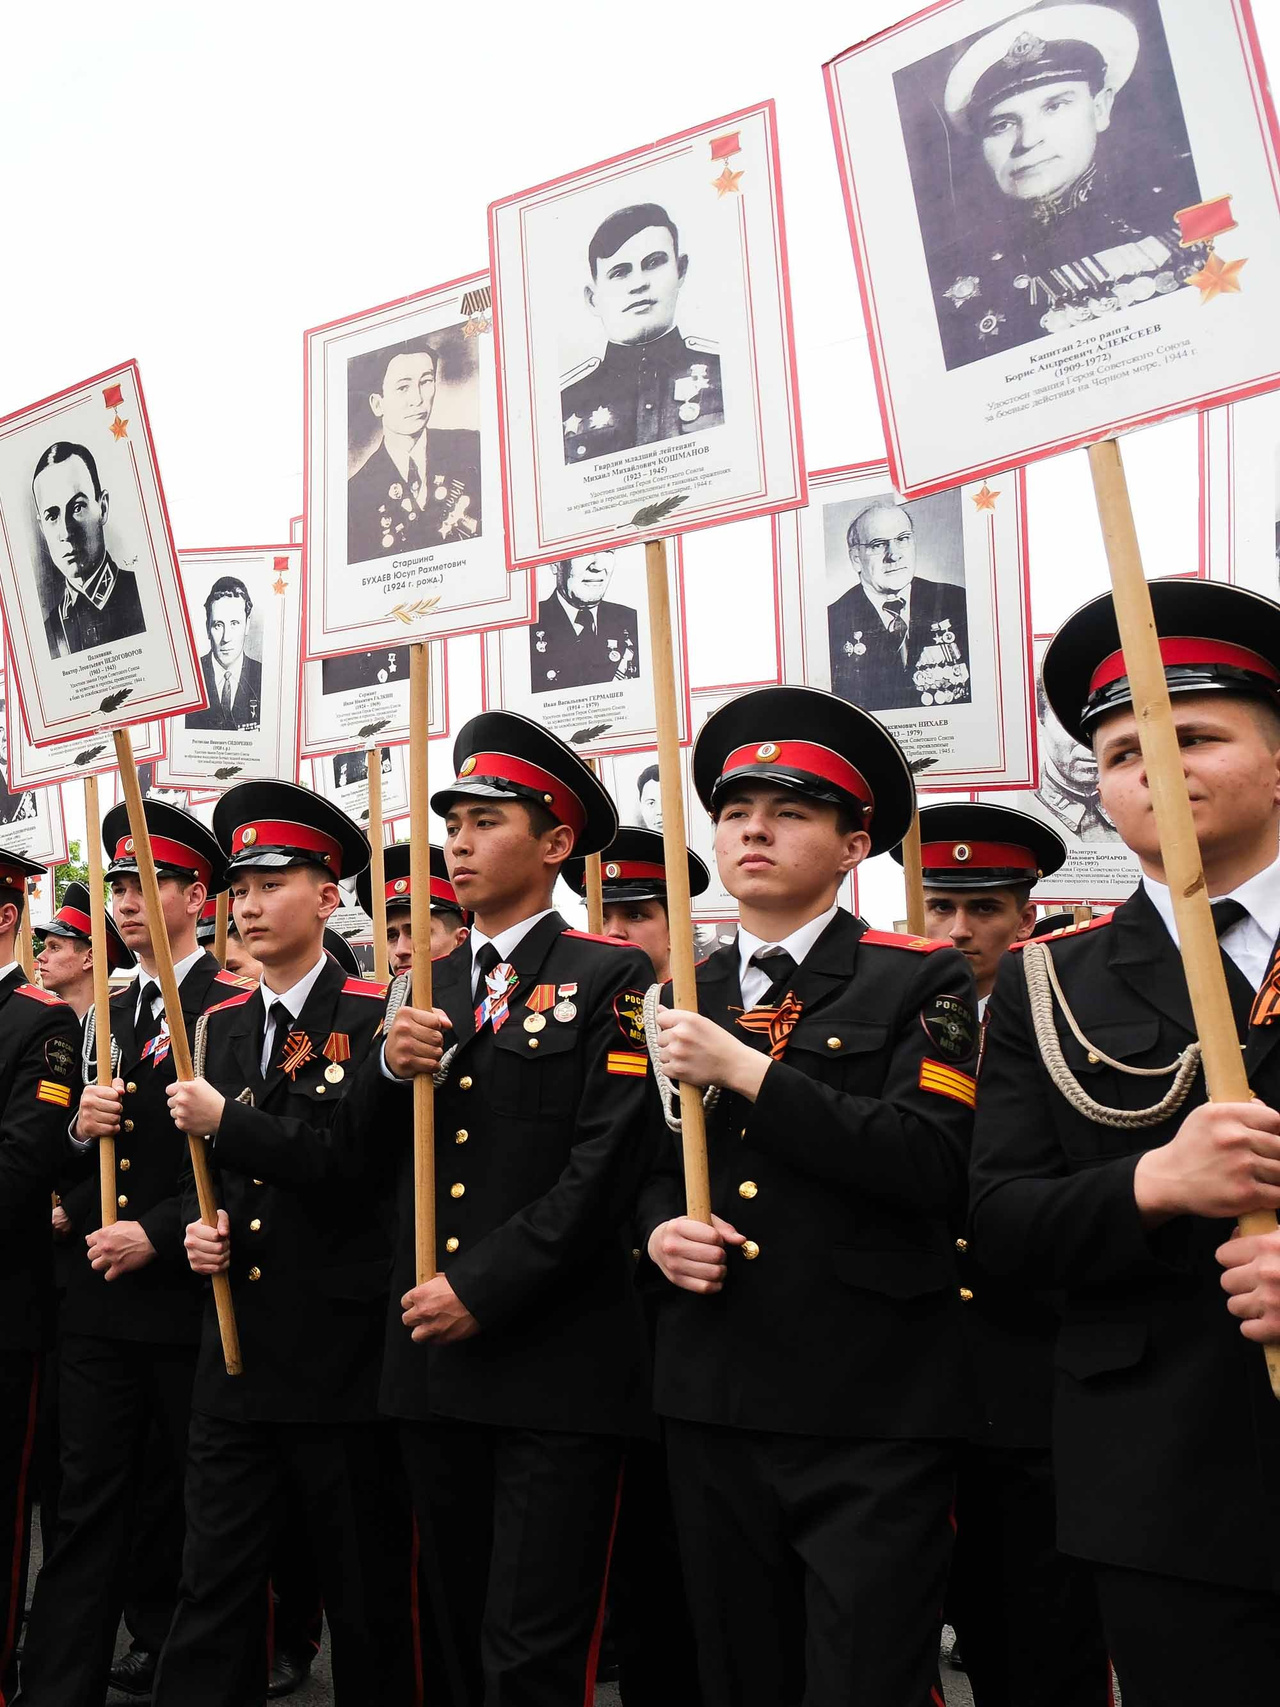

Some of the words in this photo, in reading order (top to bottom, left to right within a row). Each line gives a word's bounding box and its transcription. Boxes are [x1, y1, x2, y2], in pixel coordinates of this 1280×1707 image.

[1005, 369, 1035, 383] Борис
[1038, 349, 1093, 372] Андреевич
[1097, 324, 1162, 352] АЛЕКСЕЕВ
[1030, 344, 1074, 364] Капитан
[1076, 337, 1096, 348] 2-го
[1099, 326, 1130, 342] ранга
[987, 392, 1030, 411] Удостоен
[1067, 371, 1094, 385] Героя
[1097, 351, 1154, 374] Советского
[1156, 340, 1191, 354] Союза
[1032, 388, 1075, 408] действия
[1077, 384, 1090, 392] на
[1092, 371, 1130, 386] Черном
[1164, 350, 1188, 364] 1944
[1054, 353, 1112, 377] (1909-1972)
[583, 469, 610, 483] Михаил
[612, 461, 656, 476] Михайлович
[658, 446, 710, 465] КОШМАНОВ
[594, 460, 623, 472] Гвардии
[625, 450, 657, 463] младший
[659, 442, 696, 457] лейтенант
[623, 472, 641, 483] (1923
[649, 466, 668, 476] 1945)
[362, 573, 391, 586] БУХАЕВ
[393, 570, 416, 580] Юсуп
[418, 560, 467, 574] Рахметович
[392, 555, 434, 569] Старшина
[383, 581, 406, 594] (1924
[416, 574, 444, 588] рожд.)
